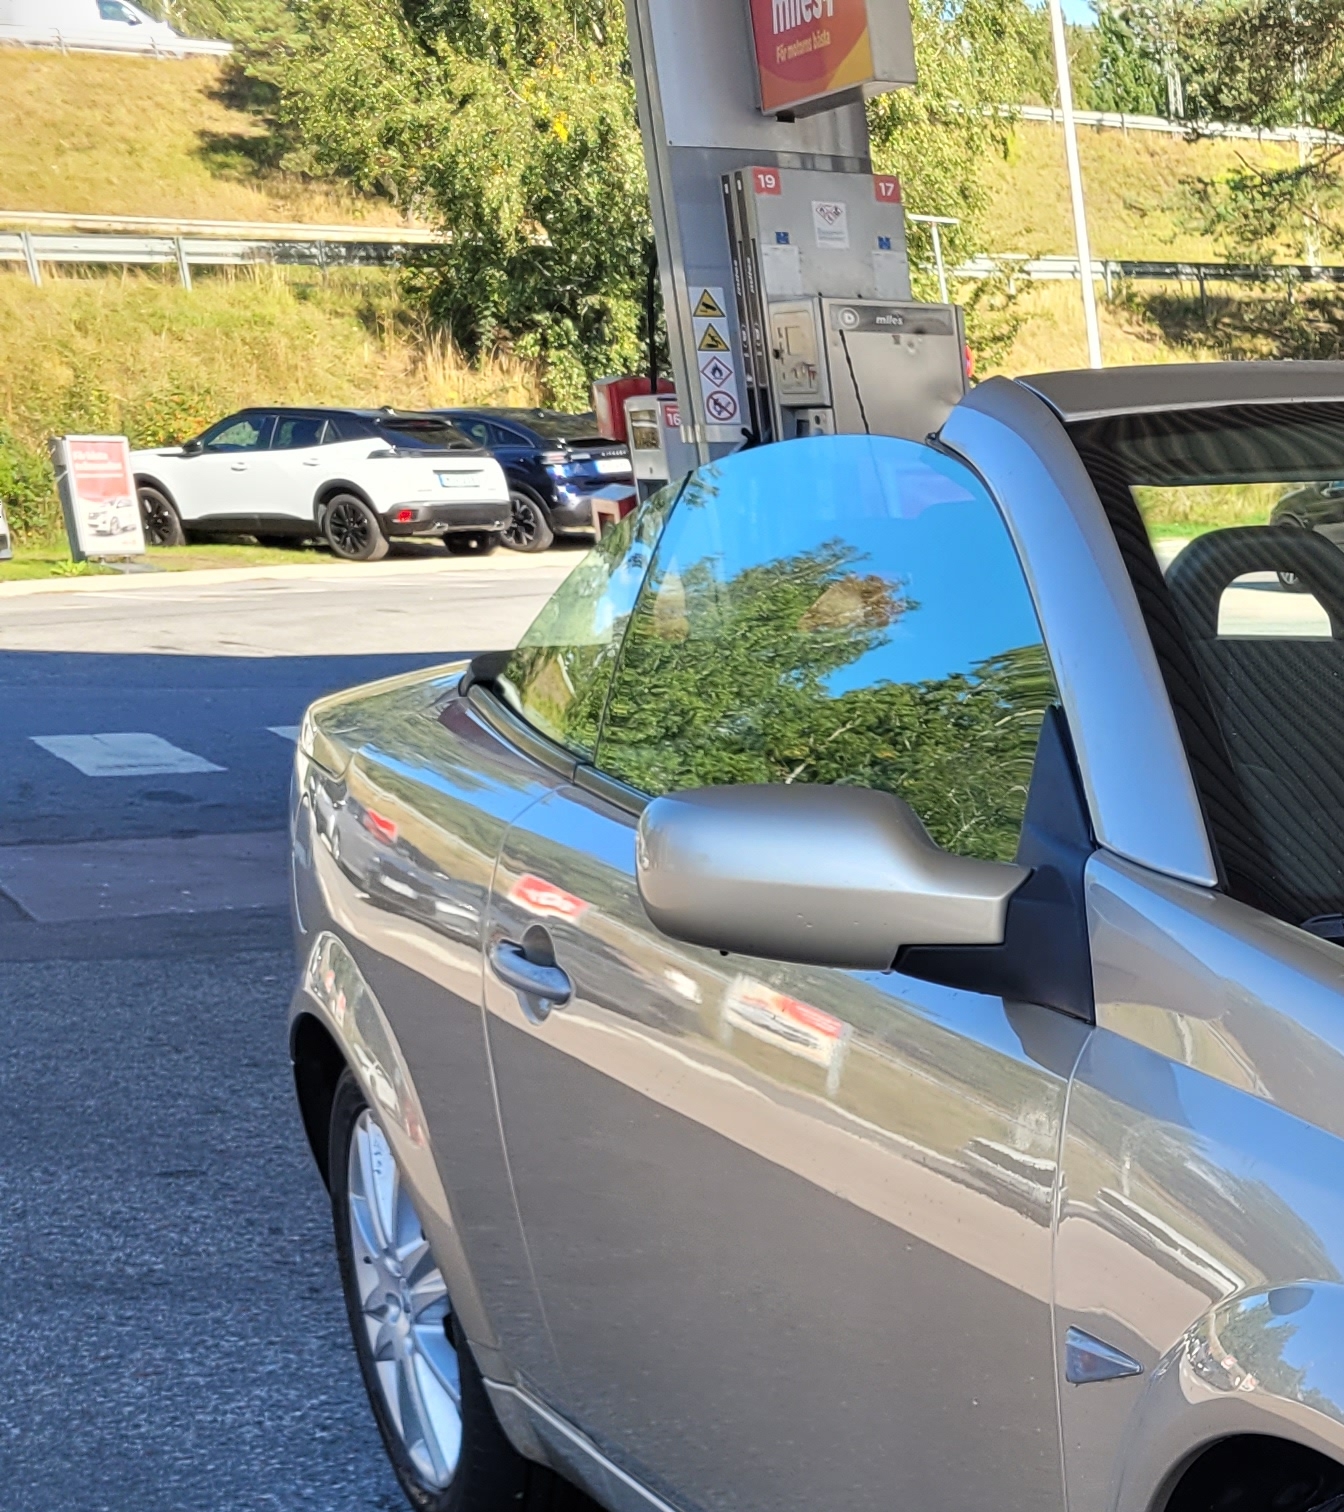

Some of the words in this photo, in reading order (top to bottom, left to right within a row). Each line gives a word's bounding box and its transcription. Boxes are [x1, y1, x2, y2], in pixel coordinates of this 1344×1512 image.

[758, 174, 776, 189] 19
[878, 183, 894, 197] 17
[876, 315, 903, 325] miles
[667, 413, 681, 426] 16
